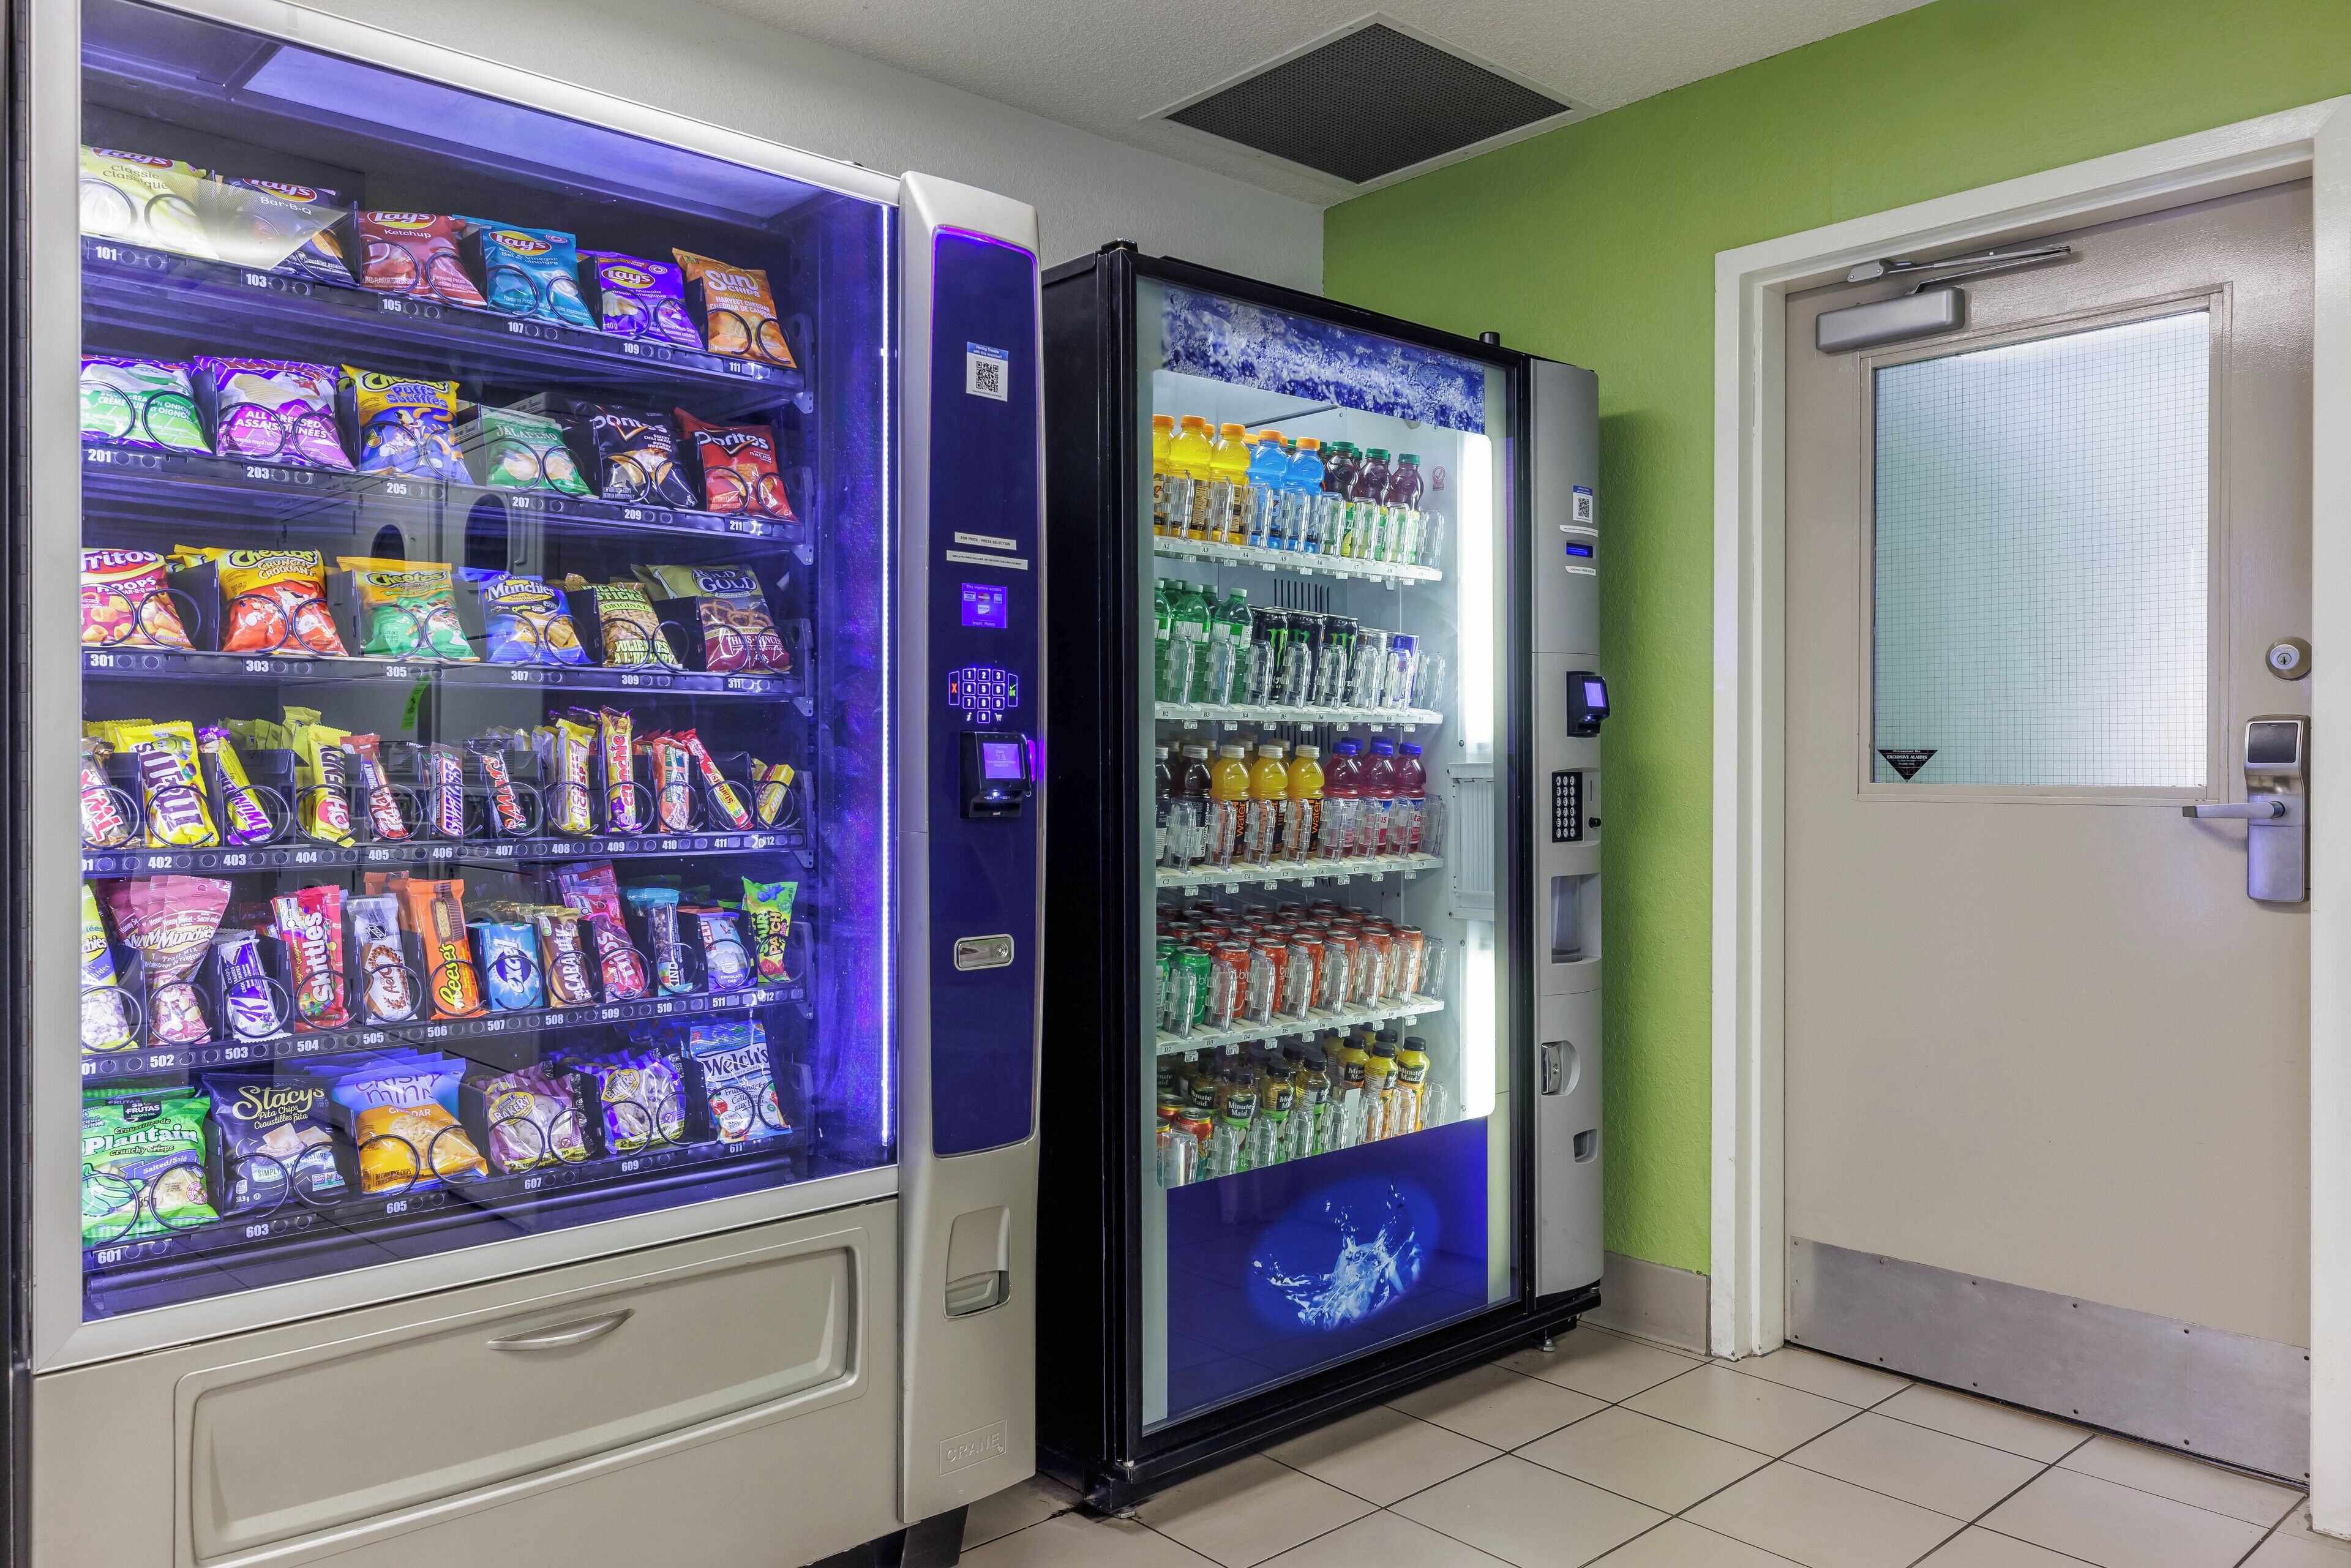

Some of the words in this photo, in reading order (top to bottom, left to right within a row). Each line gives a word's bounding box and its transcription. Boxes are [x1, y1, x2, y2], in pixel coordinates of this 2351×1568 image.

[384, 230, 431, 239] Ketchup
[496, 234, 547, 250] Lay's
[96, 246, 116, 261] 101
[246, 274, 266, 288] 103
[609, 270, 650, 284] Lay's
[705, 270, 758, 291] Sun
[727, 285, 760, 298] CHIPS
[383, 299, 401, 312] 105
[716, 296, 743, 306] HARVEST
[744, 300, 770, 312] CHEDDAR
[508, 321, 523, 333] 107
[623, 342, 639, 354] 109
[729, 362, 740, 372] 111
[391, 386, 435, 397] Puffs
[246, 411, 267, 419] ALL
[590, 415, 667, 433] Doritos
[496, 425, 558, 441] JALAPEÑO
[694, 431, 769, 449] Doritos
[88, 449, 111, 462] 201
[750, 452, 771, 461] NACHO
[247, 466, 269, 479] 203
[387, 482, 407, 494] 205
[512, 496, 529, 508] 207
[624, 509, 642, 520] 209
[730, 520, 742, 531] 211
[81, 550, 157, 572] Fritos
[258, 558, 315, 571] CRUNCHY
[258, 566, 317, 579] CROQUANT
[96, 576, 156, 593] HOOPS
[368, 572, 443, 586] Cheetos
[699, 577, 757, 591] GOLD
[487, 582, 555, 602] Munchies
[597, 591, 646, 602] STICKS
[91, 655, 113, 667] 301
[246, 661, 269, 672] 303
[386, 666, 407, 677] 305
[511, 670, 528, 681] 307
[622, 675, 639, 685] 309
[728, 678, 741, 688] 311
[445, 763, 462, 836] SNICKERS
[1237, 801, 1247, 837] water
[1311, 800, 1321, 833] water
[552, 843, 570, 853] 408
[607, 842, 625, 852] 409
[662, 840, 677, 850] 410
[714, 838, 727, 847] 411
[369, 849, 389, 860] 405
[433, 847, 452, 857] 406
[495, 846, 513, 855] 407
[148, 857, 172, 869] 402
[223, 854, 246, 866] 403
[296, 851, 317, 863] 404
[163, 918, 177, 927] Honey
[158, 926, 215, 949] Munchies
[768, 911, 782, 955] PATCH
[302, 911, 335, 1003] Skittles
[501, 939, 525, 993] excel
[438, 943, 466, 1010] Reese's
[658, 1003, 672, 1013] 510
[713, 997, 726, 1007] 511
[602, 1009, 620, 1019] 509
[487, 1021, 504, 1030] 507
[546, 1015, 563, 1026] 508
[428, 1026, 447, 1037] 506
[363, 1032, 384, 1044] 505
[297, 1040, 319, 1051] 504
[225, 1047, 248, 1059] 503
[150, 1055, 174, 1067] 502
[701, 1047, 769, 1076] Welch's
[1398, 1065, 1422, 1077] Minute
[604, 1071, 636, 1099] BAKERY
[126, 1105, 160, 1114] FRUTAS
[278, 1105, 299, 1114] Chips
[493, 1095, 530, 1121] BAKERY
[1228, 1101, 1254, 1111] Minute
[1231, 1108, 1248, 1117] Maid
[254, 1114, 292, 1130] Croustilles
[293, 1113, 308, 1123] pita
[82, 1124, 198, 1157] Plantain
[110, 1146, 146, 1155] Crunchy
[730, 1143, 743, 1153] 611
[143, 1155, 187, 1175] Salted/Salé
[258, 1167, 280, 1177] SIMPLY
[306, 1152, 327, 1161] NATURE
[621, 1160, 639, 1172] 609
[375, 1171, 391, 1180] BROWN
[525, 1177, 541, 1189] 607
[386, 1201, 407, 1214] 605
[246, 1225, 269, 1238] 603
[98, 1250, 121, 1264] 601
[947, 1432, 999, 1462] CRANE
